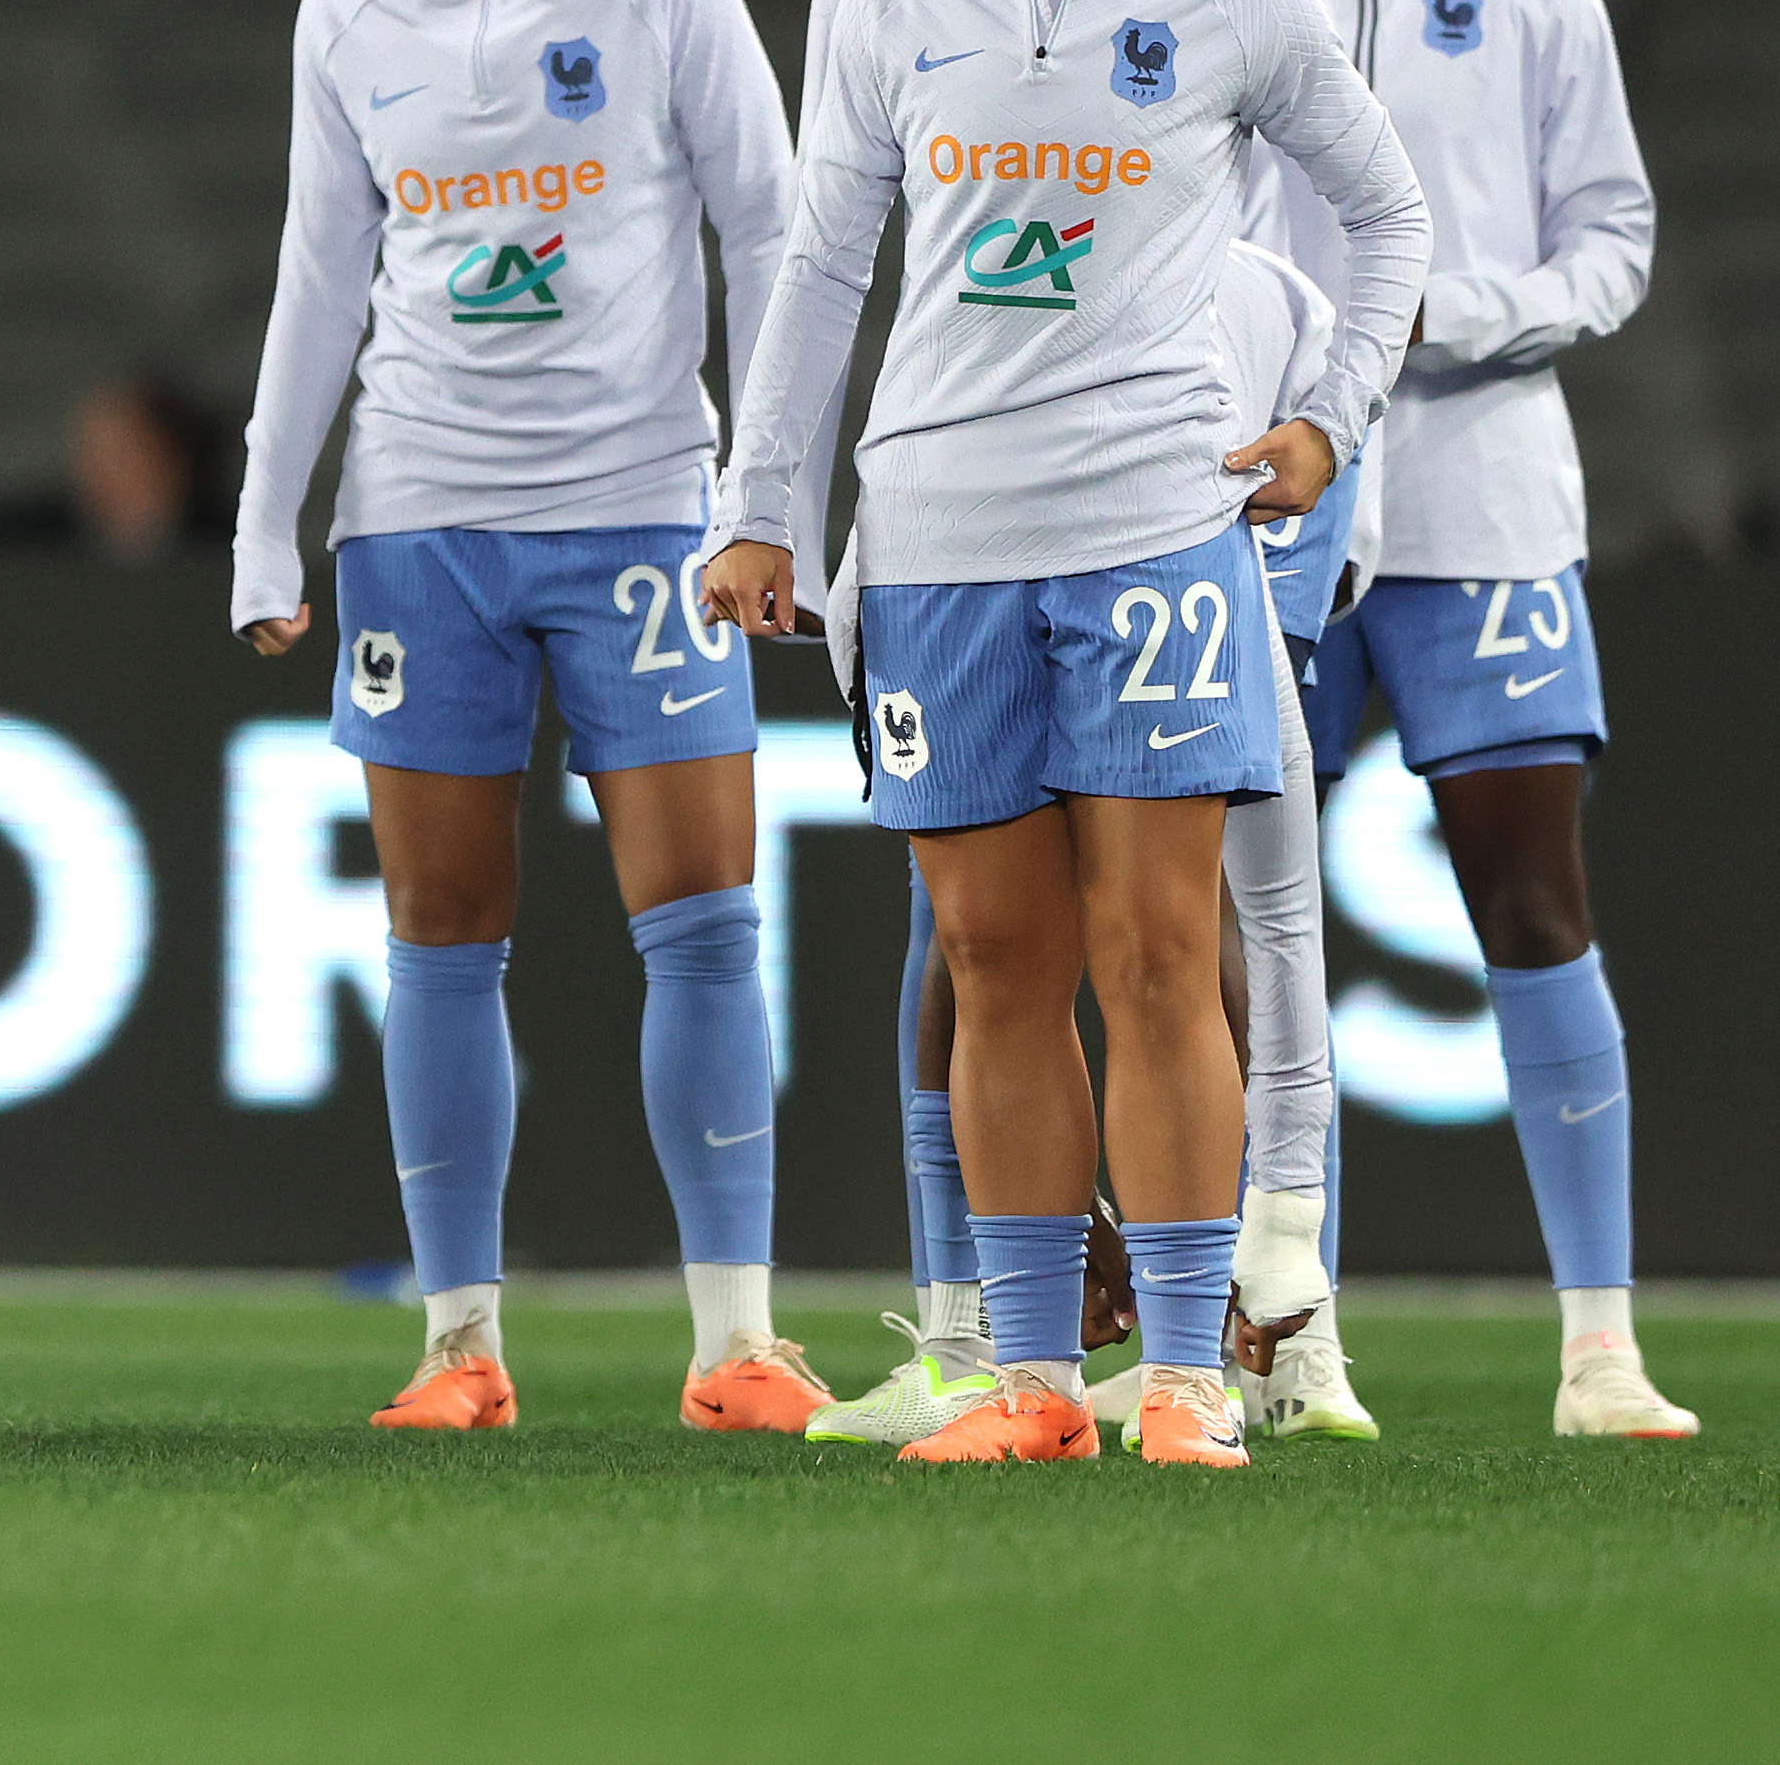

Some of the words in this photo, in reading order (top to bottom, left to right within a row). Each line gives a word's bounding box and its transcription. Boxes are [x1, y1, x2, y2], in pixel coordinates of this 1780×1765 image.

[394, 158, 605, 215] Orange
[928, 134, 1152, 196] Orange
[1112, 579, 1230, 703] 22
